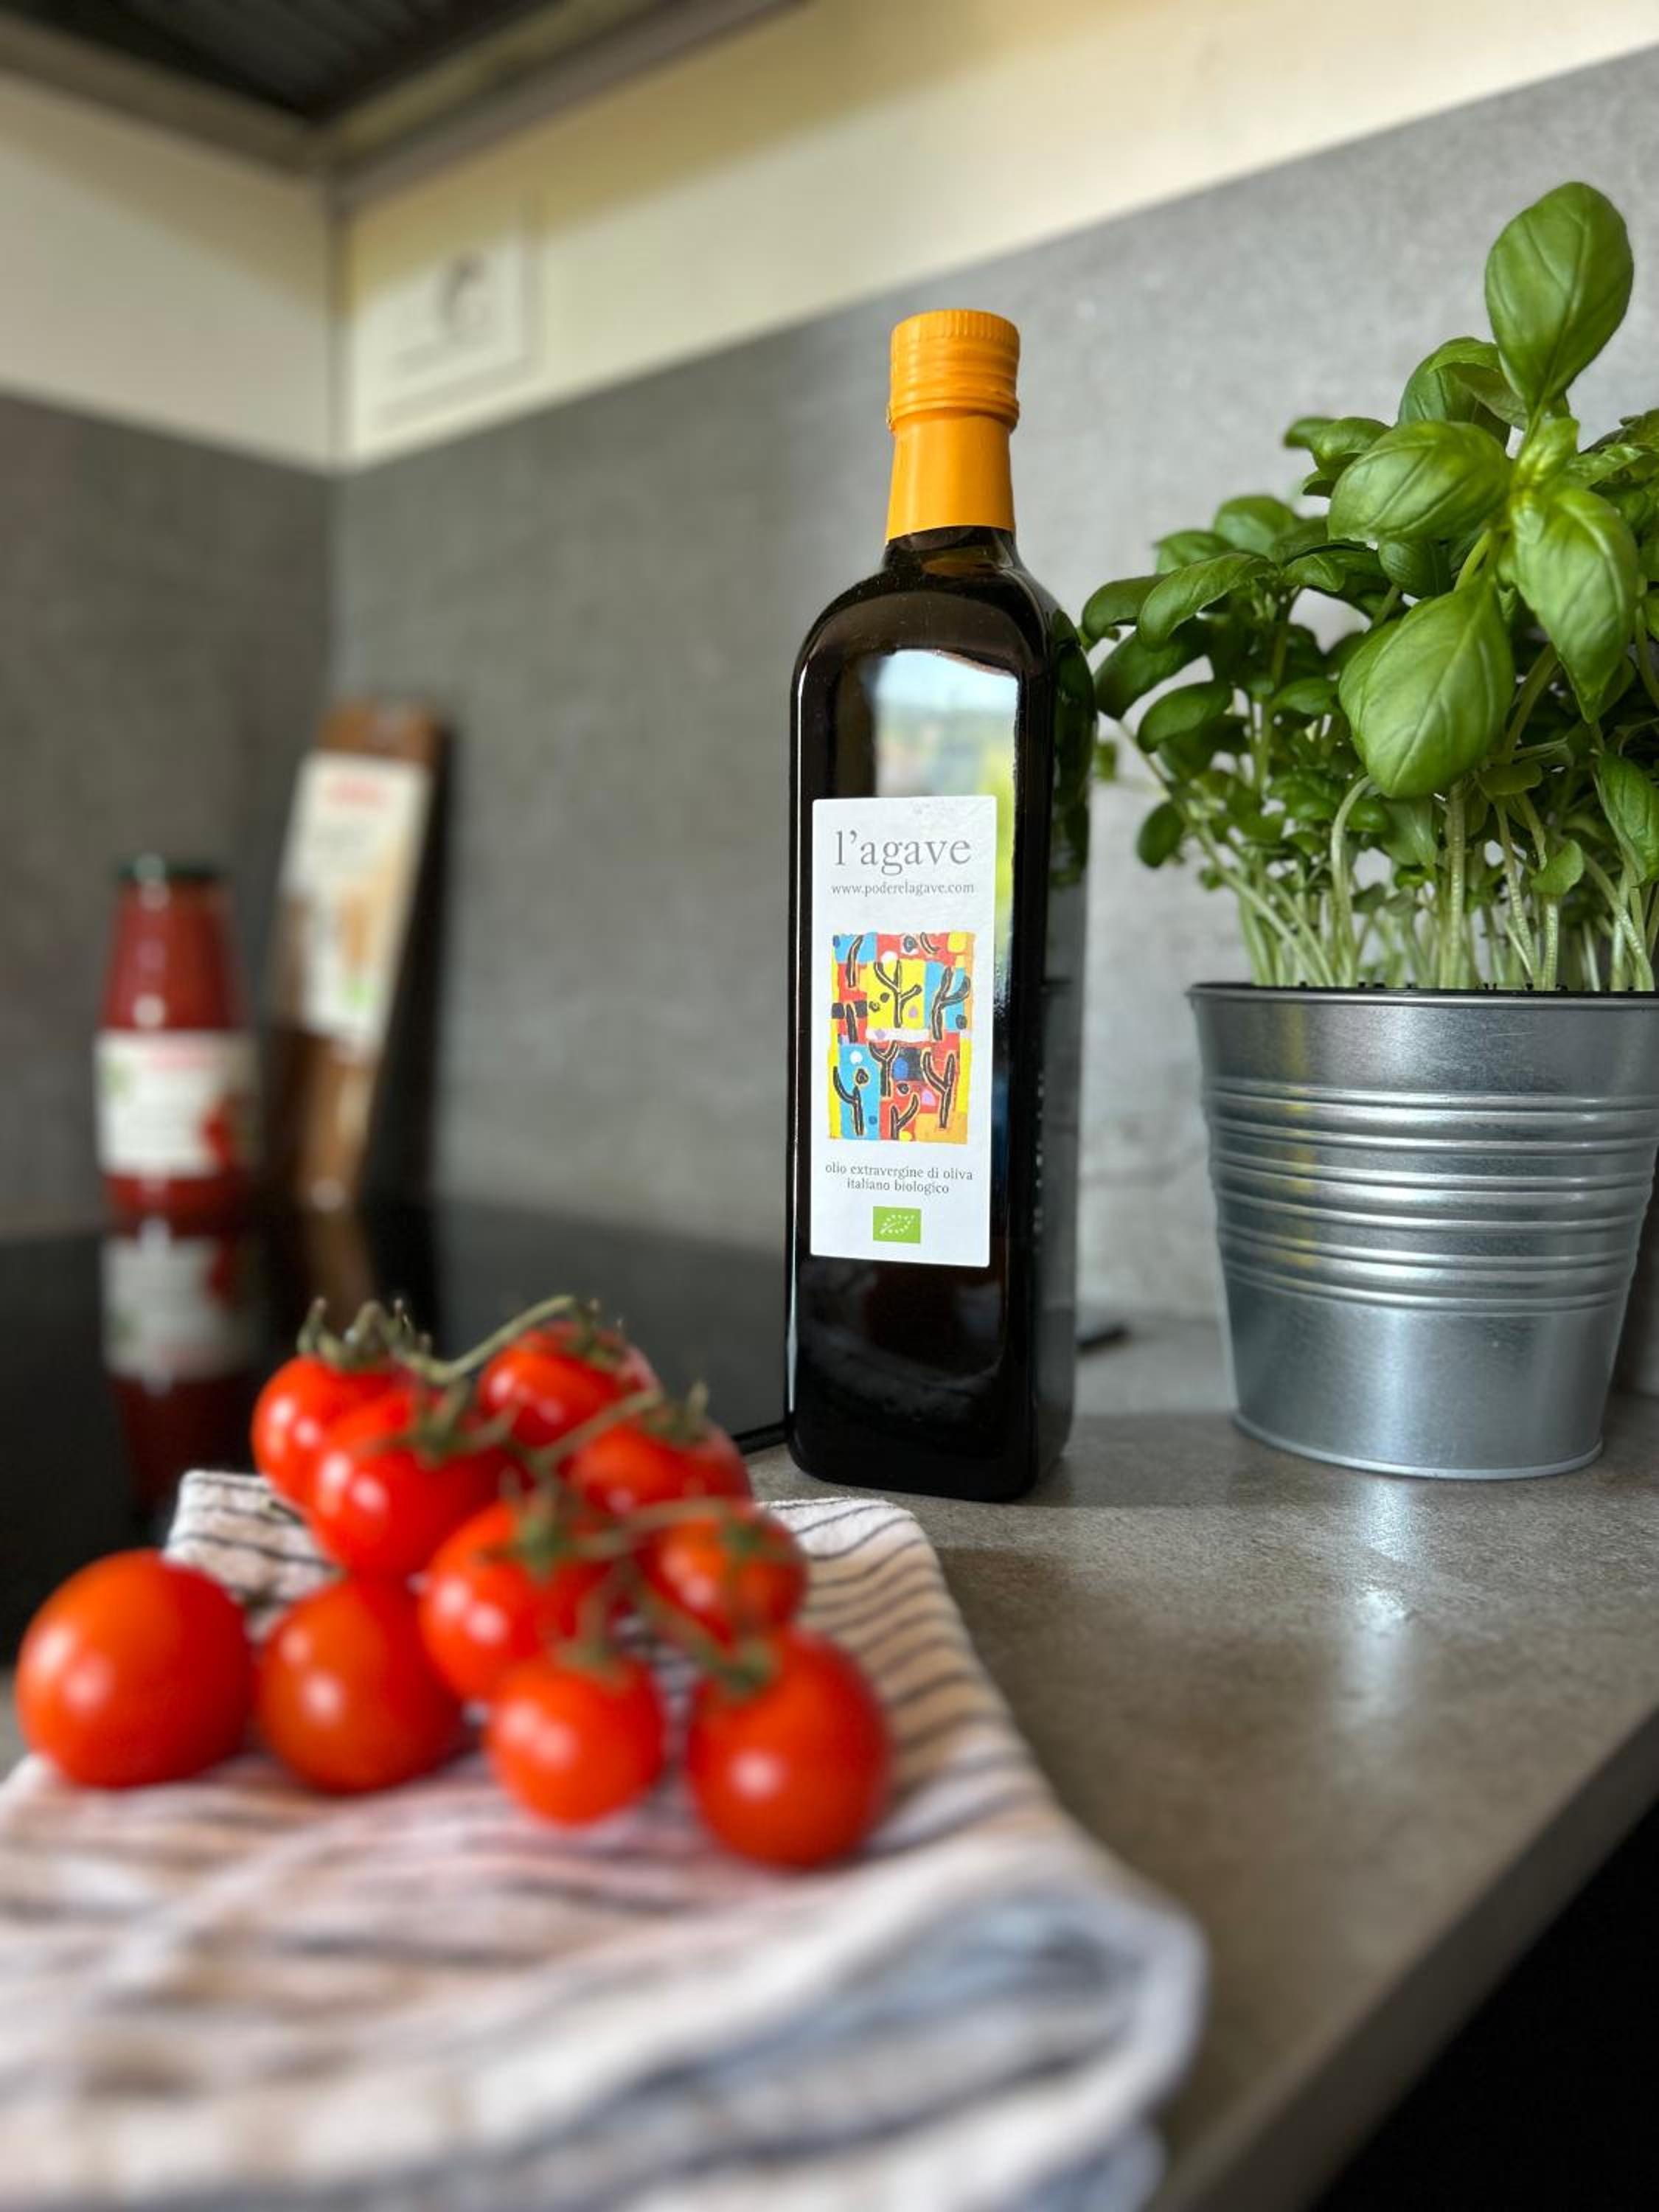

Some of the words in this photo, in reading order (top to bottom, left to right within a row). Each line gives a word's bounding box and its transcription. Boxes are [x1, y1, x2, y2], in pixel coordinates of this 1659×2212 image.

[835, 830, 972, 876] l’agave
[832, 880, 974, 897] www.poderelagave.com
[825, 1161, 847, 1174] olio
[850, 1165, 924, 1180] extravergine
[927, 1168, 939, 1179] di
[943, 1168, 973, 1180] oliva
[846, 1178, 890, 1191] italiano
[894, 1180, 949, 1195] biologico
